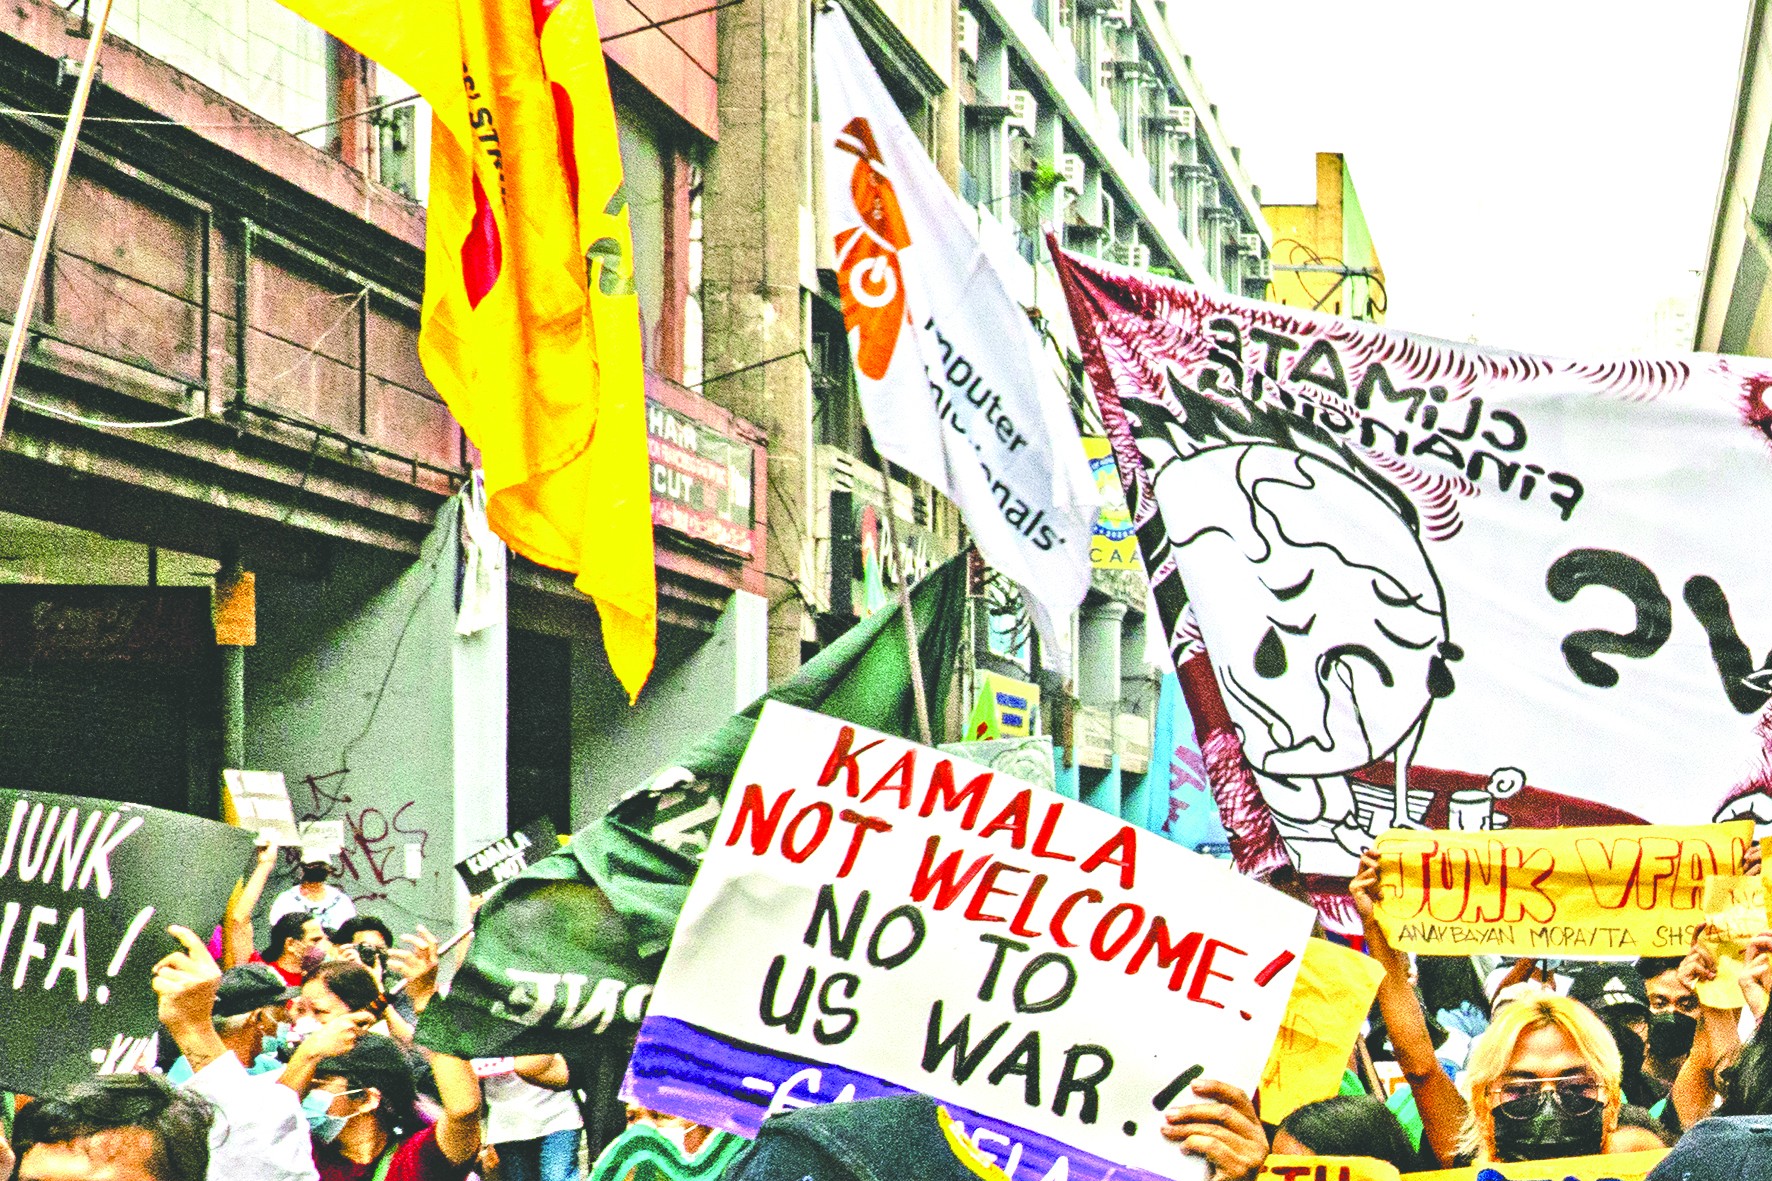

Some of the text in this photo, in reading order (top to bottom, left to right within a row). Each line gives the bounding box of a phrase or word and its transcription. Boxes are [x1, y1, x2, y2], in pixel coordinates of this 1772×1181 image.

[653, 463, 694, 502] CUT
[0, 799, 145, 900] JUNK
[817, 726, 1138, 891] KAMALA
[726, 783, 1296, 1022] NOT WELCOME!
[1378, 837, 1557, 925] JUNK
[804, 883, 1078, 1015] NO TO
[759, 954, 861, 1046] US
[921, 1000, 1205, 1137] WAR!
